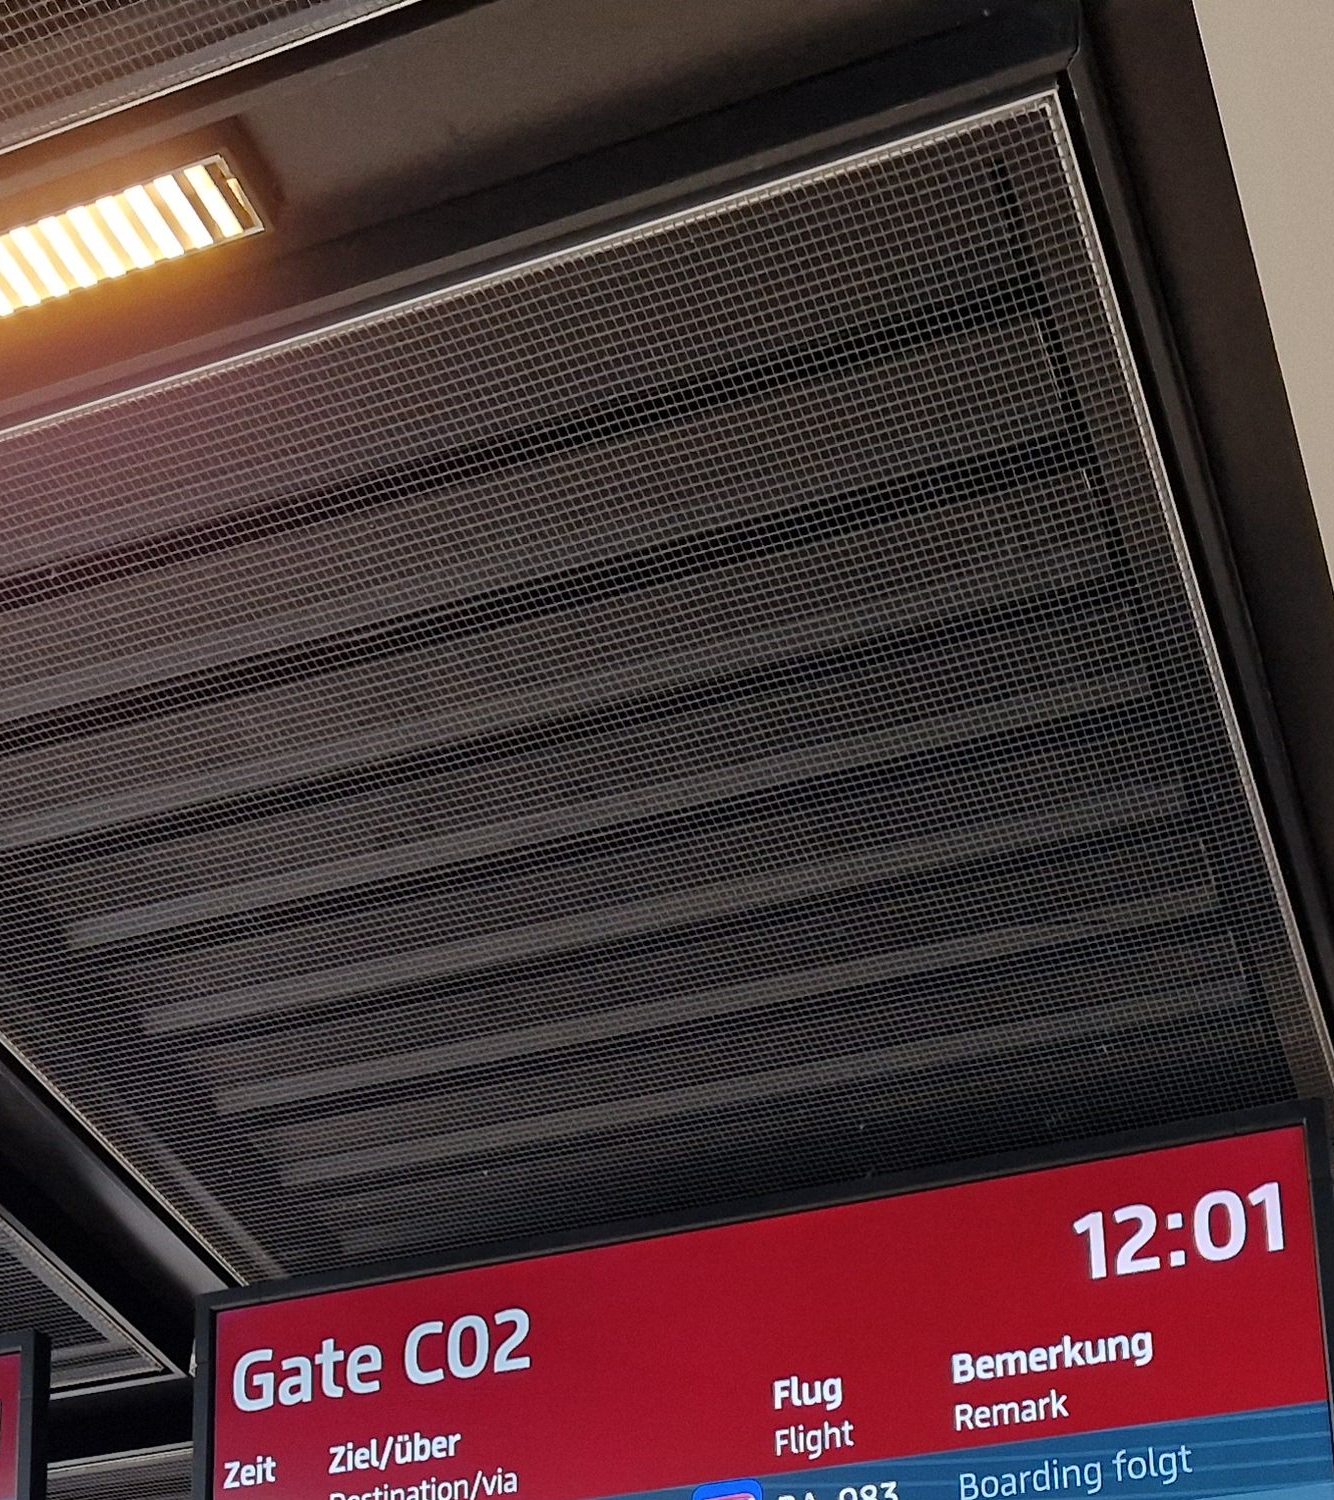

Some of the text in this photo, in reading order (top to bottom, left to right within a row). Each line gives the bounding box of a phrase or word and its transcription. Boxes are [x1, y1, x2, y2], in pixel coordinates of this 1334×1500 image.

[1072, 1181, 1285, 1280] 12:01
[232, 1308, 531, 1412] Gate C02
[222, 1330, 1154, 1490] Zeit Ziel/über Flug Bemerkung
[774, 1420, 855, 1461] Flight
[953, 1389, 1070, 1432] Remark
[1110, 1443, 1195, 1485] folgt
